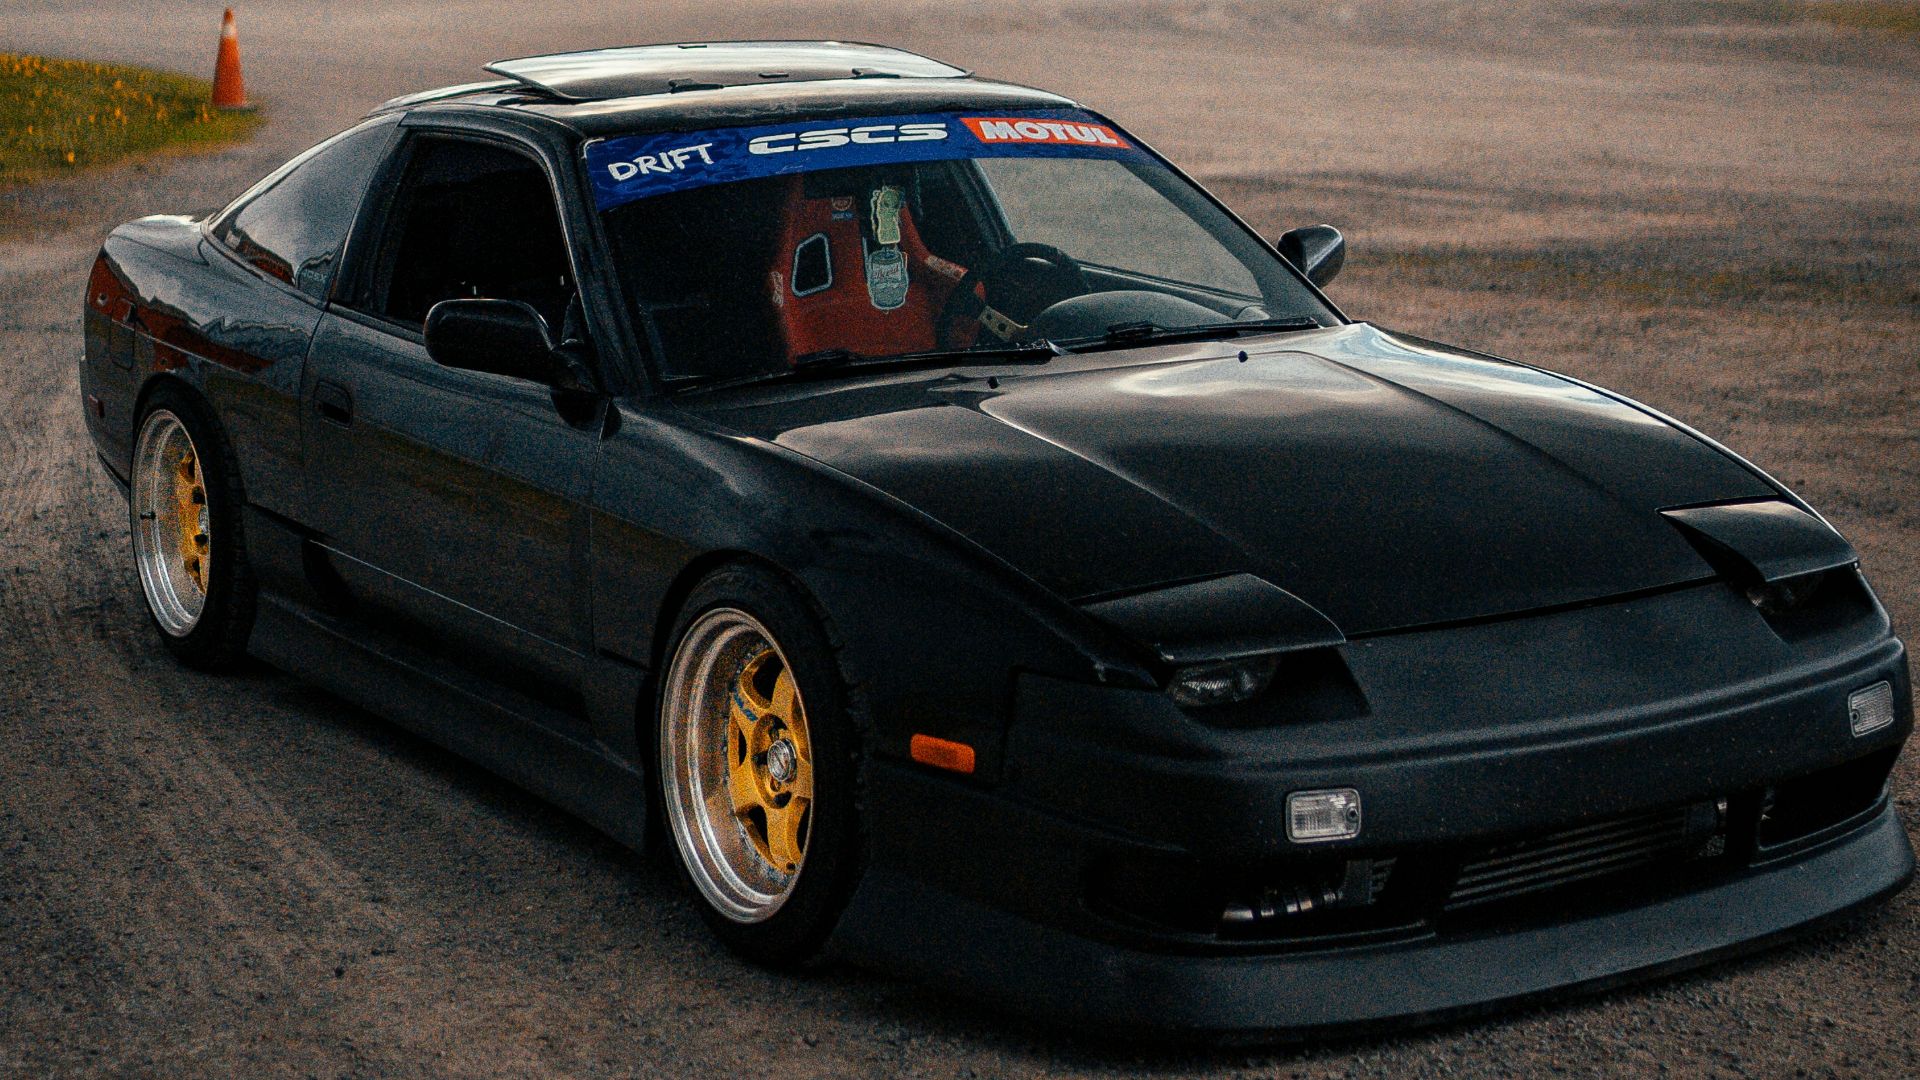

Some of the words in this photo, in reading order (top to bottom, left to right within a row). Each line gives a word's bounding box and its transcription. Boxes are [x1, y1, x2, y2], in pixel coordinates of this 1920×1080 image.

[748, 123, 948, 155] CSCS
[979, 120, 1118, 145] MOTUL
[607, 142, 714, 181] DRIFT
